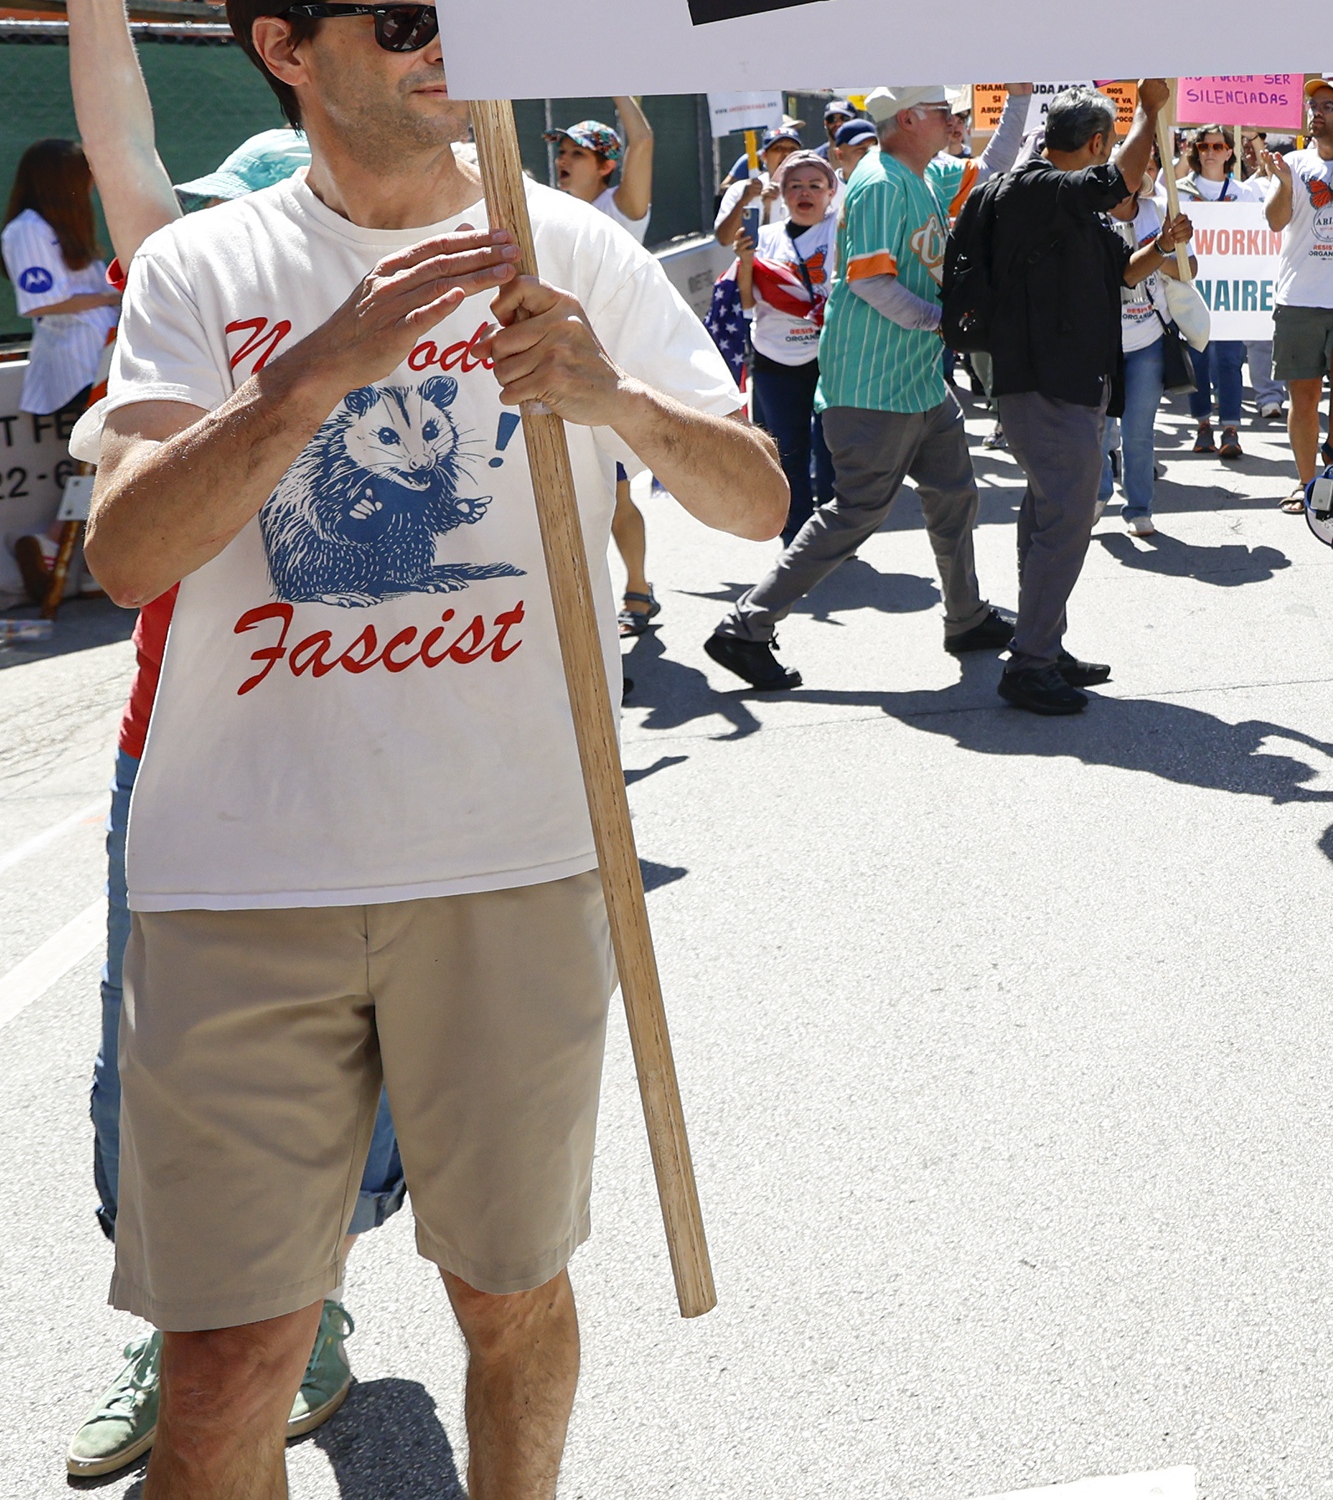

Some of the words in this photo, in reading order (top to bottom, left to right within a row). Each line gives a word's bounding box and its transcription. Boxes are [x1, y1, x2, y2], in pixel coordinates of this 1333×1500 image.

[1264, 74, 1291, 84] SER
[1186, 89, 1288, 106] SILENCIADAS
[1194, 228, 1283, 257] WORKIN
[1195, 279, 1278, 312] NAIRE
[233, 599, 526, 696] Fascist
